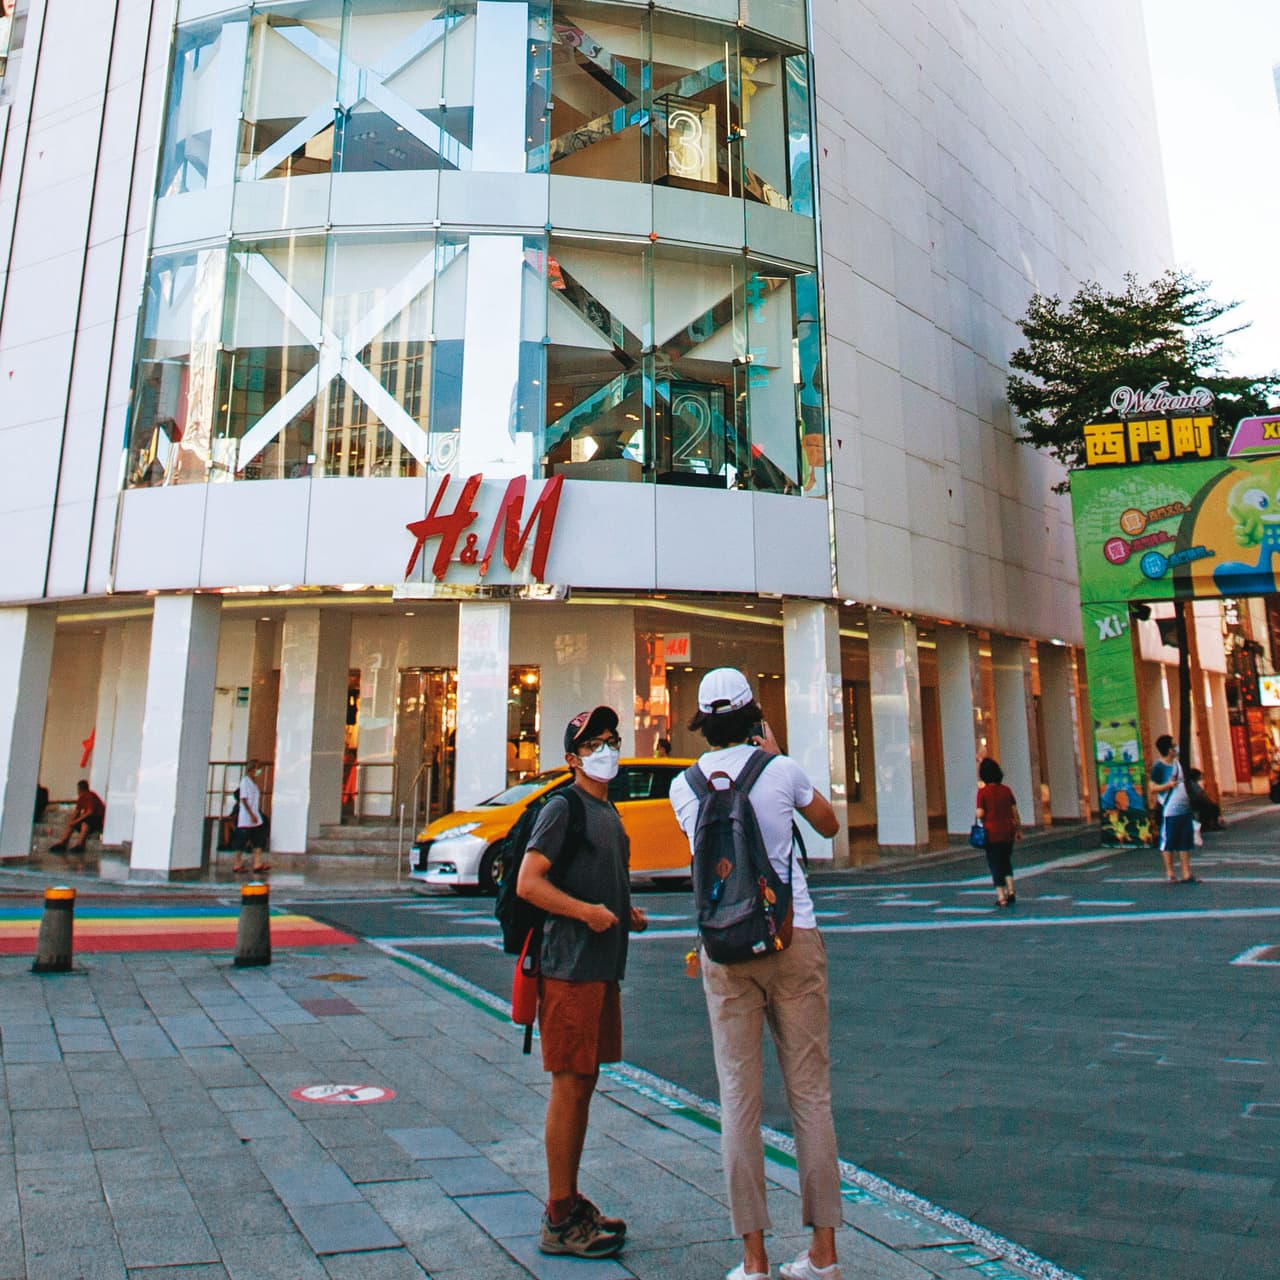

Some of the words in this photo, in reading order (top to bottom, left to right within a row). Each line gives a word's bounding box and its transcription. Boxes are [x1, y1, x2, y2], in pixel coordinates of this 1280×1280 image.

[1110, 382, 1214, 415] Welcome
[1083, 416, 1214, 465] 西門町
[405, 473, 565, 584] H&M
